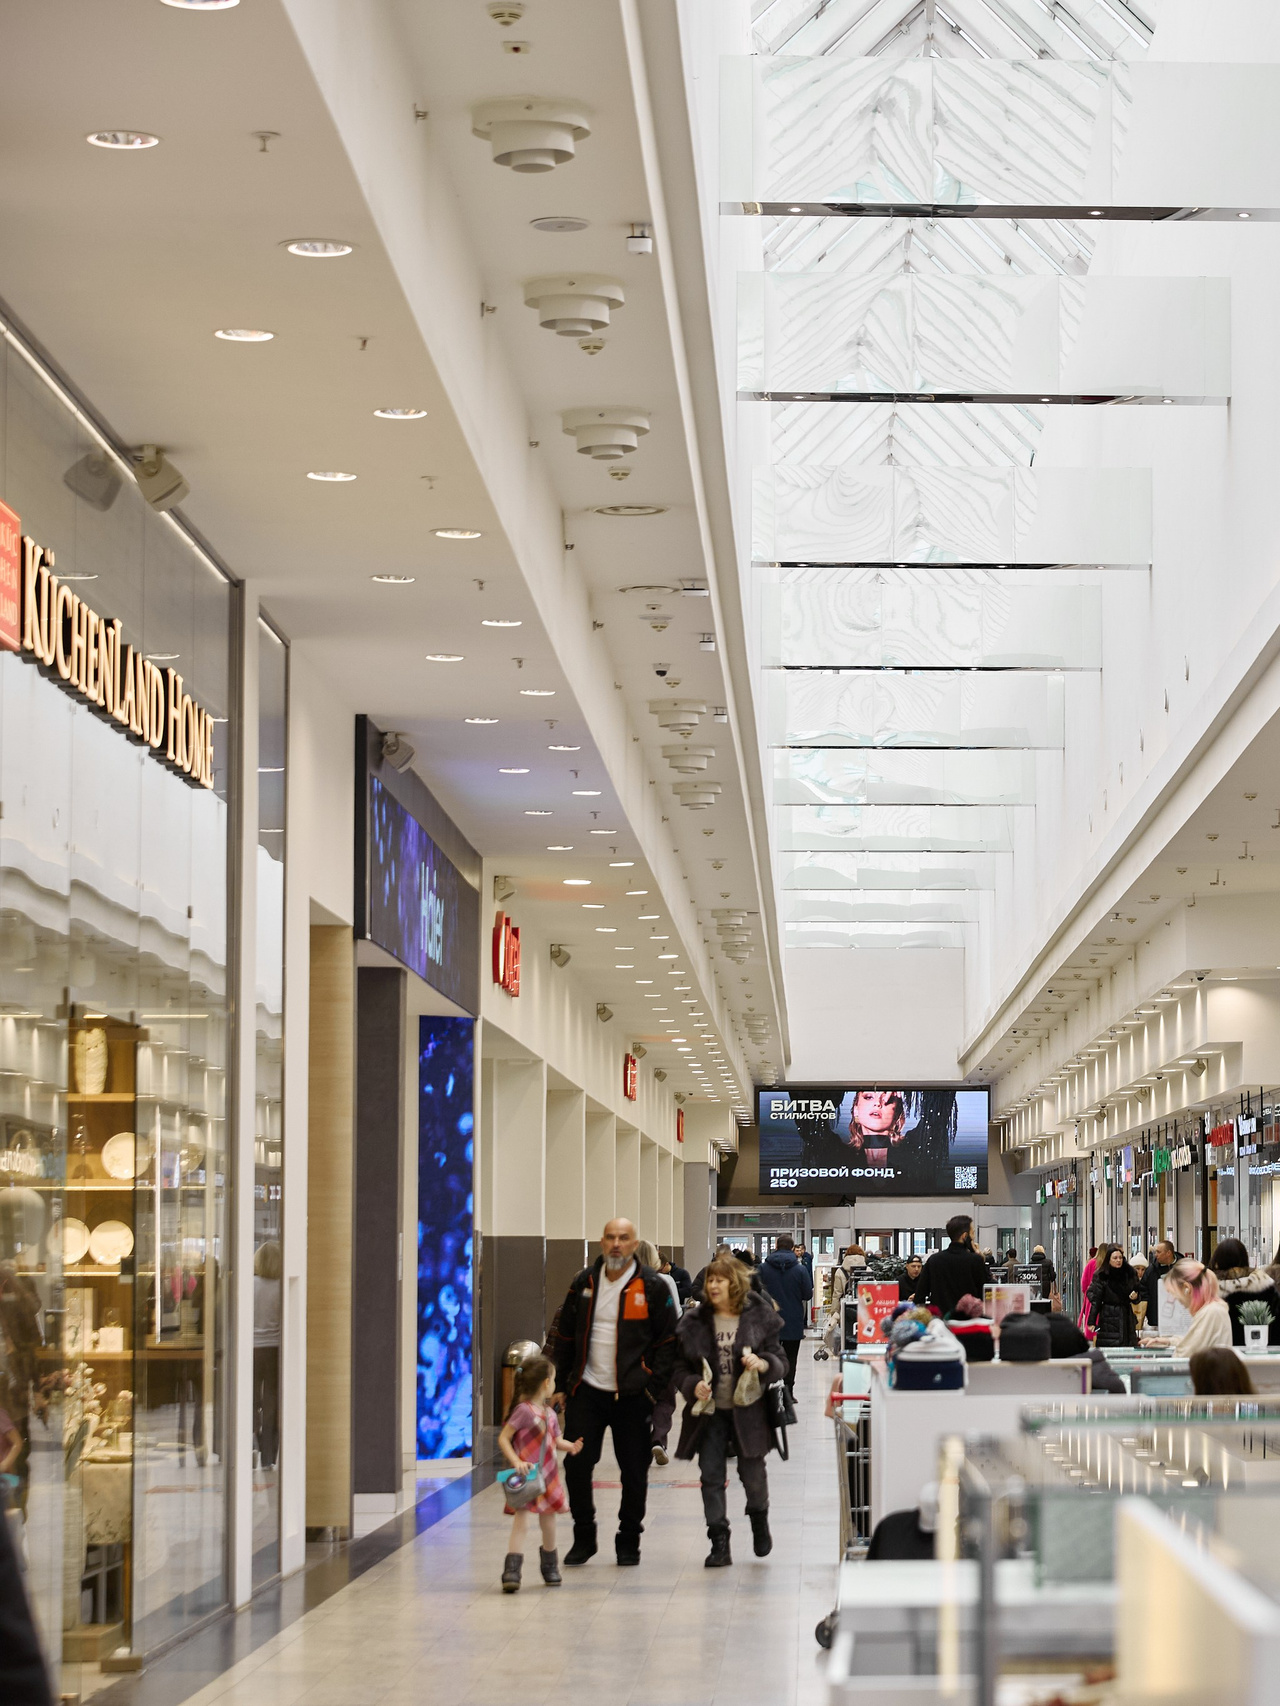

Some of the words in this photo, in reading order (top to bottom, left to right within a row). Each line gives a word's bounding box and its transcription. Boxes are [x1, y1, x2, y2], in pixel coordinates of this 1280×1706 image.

[166, 667, 214, 790] HOME
[770, 1099, 836, 1112] БИТВА
[770, 1112, 836, 1121] СТИЛИСТОВ
[770, 1166, 850, 1178] ПРИЗОВОЙ
[851, 1167, 895, 1179] ФОНД
[769, 1178, 798, 1188] 250
